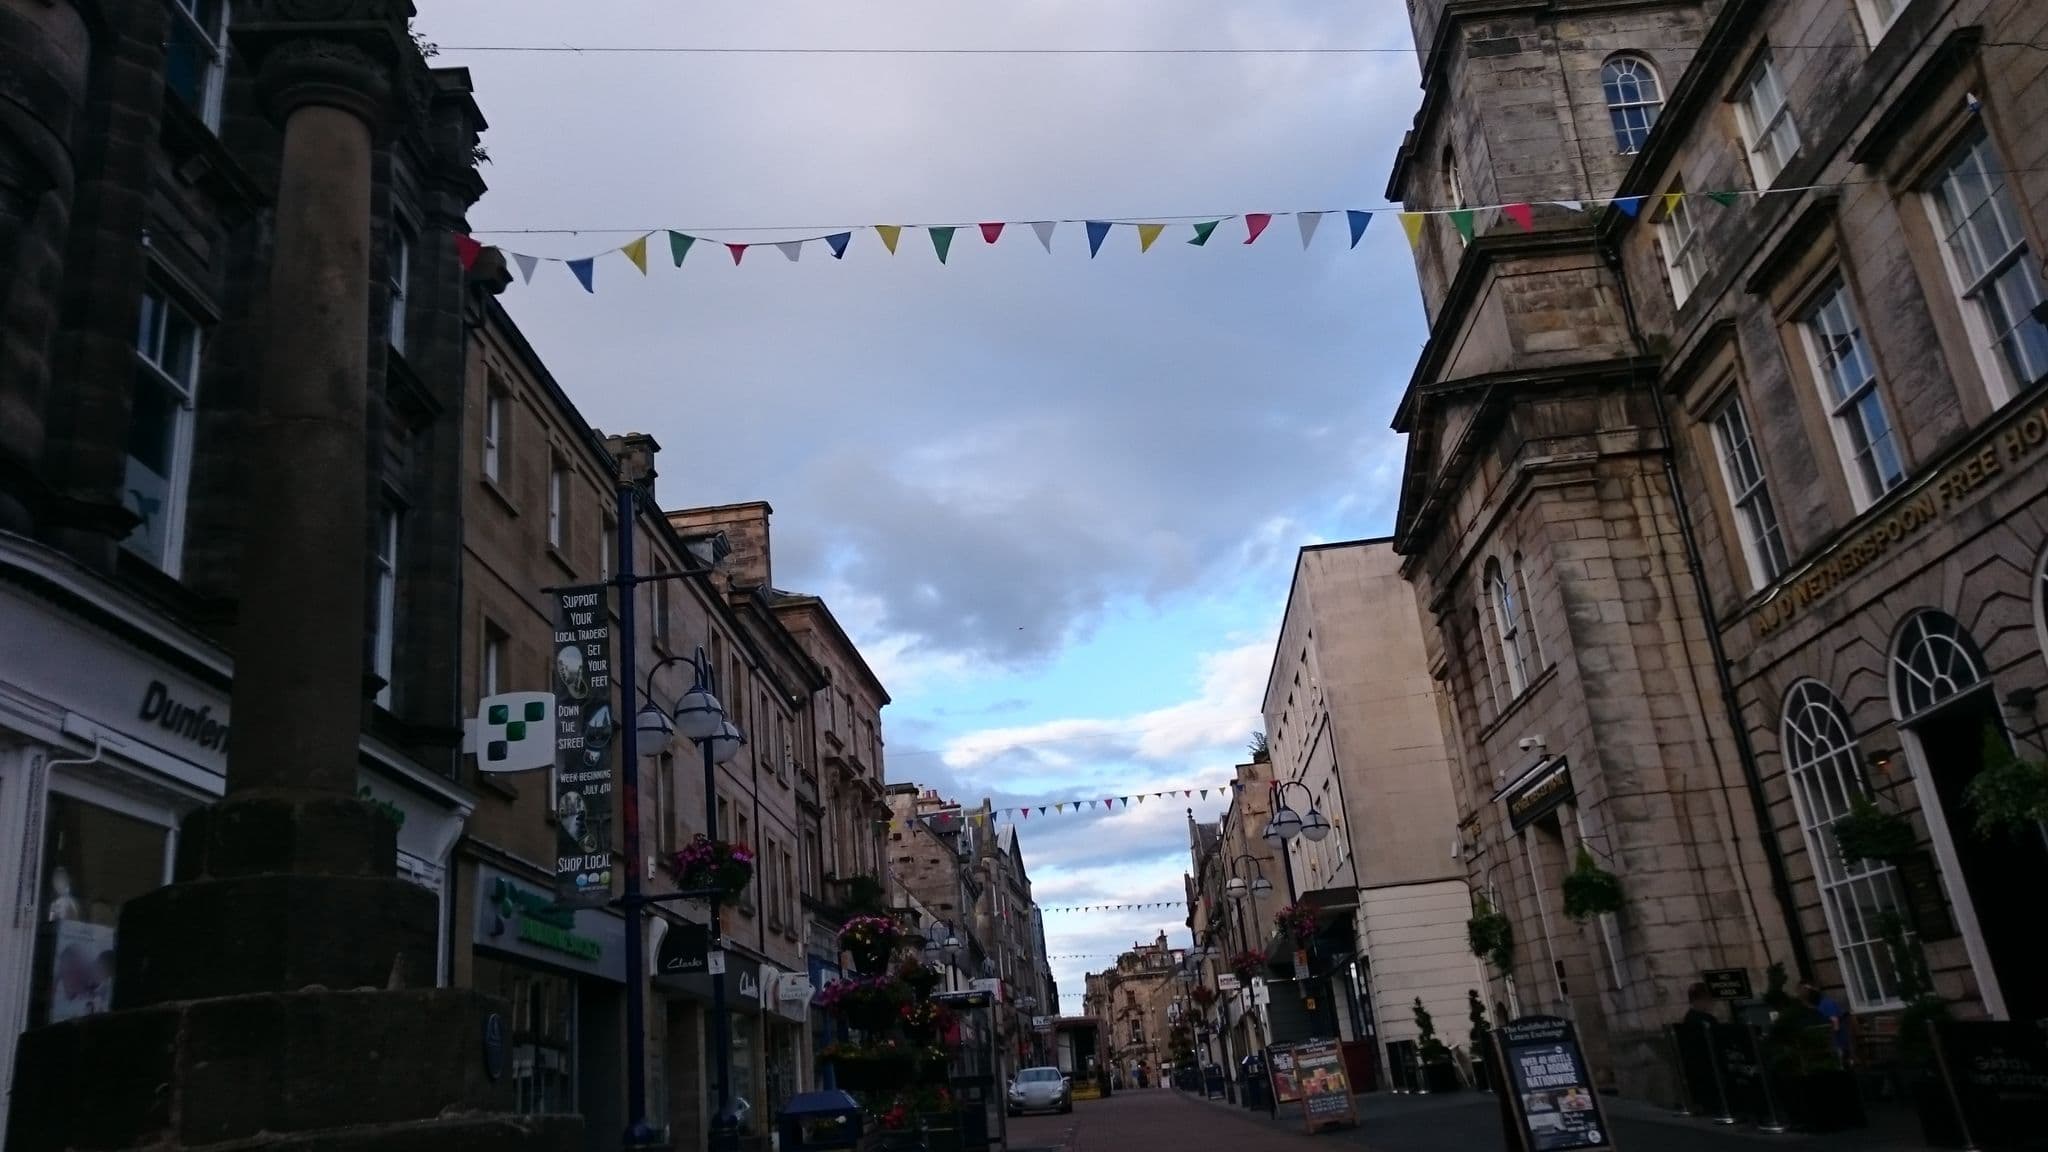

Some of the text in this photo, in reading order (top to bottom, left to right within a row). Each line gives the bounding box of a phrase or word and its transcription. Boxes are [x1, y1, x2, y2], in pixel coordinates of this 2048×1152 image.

[1791, 491, 1937, 608] WETHERSPOON
[1936, 445, 2002, 509] FREE
[562, 592, 598, 608] SUPPORT
[570, 612, 592, 626] YOUR
[555, 626, 608, 643] LOCAL TRADERS!
[587, 644, 601, 656] GET
[587, 660, 607, 672] YOUR
[591, 675, 608, 688] FEET
[558, 705, 579, 717] DOWN
[561, 721, 575, 733] THE
[558, 737, 585, 750] STREET
[560, 769, 611, 784] WEEK BEGINNING
[583, 784, 599, 796] JULY
[558, 854, 611, 873] SHOP LOCAL
